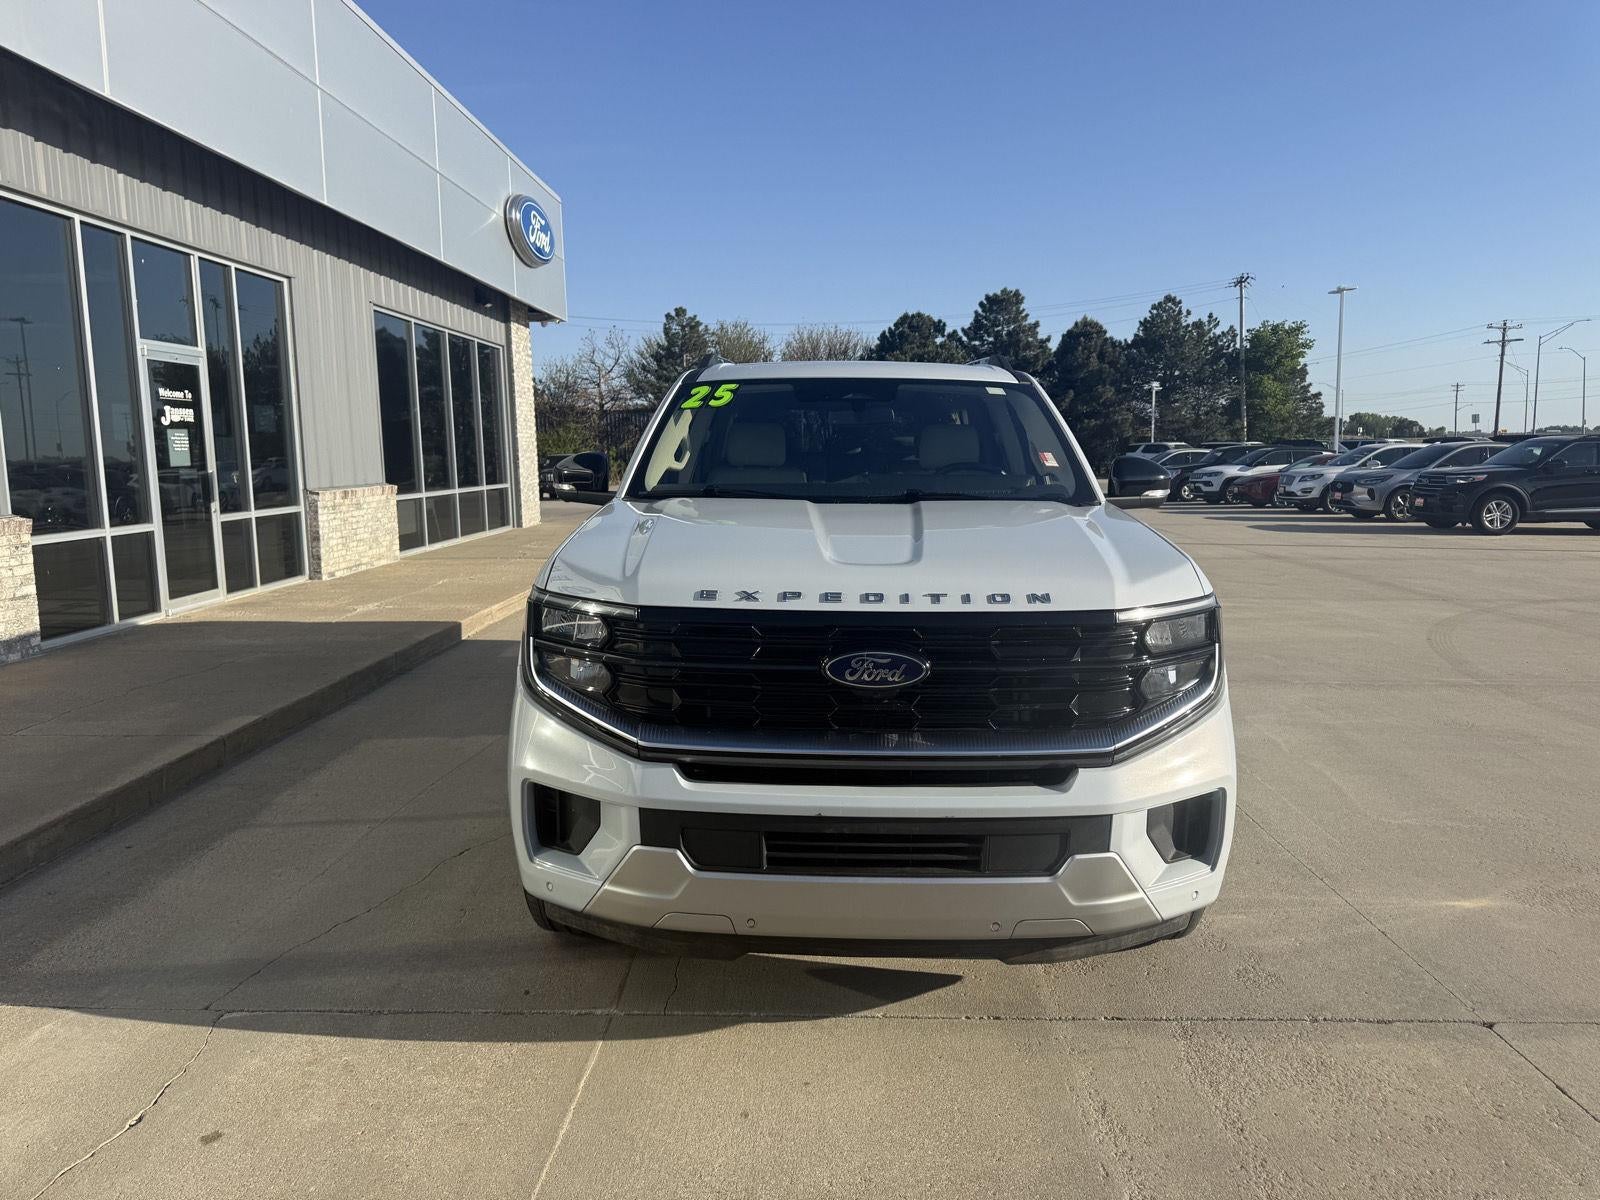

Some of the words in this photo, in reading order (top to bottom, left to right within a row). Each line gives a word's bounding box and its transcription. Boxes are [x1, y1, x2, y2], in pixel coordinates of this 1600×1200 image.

[529, 210, 551, 253] Ford
[158, 387, 184, 399] Welcome
[184, 390, 192, 399] To
[680, 383, 740, 409] 25
[693, 588, 1052, 605] EXPEDITION
[844, 656, 907, 683] Ford
